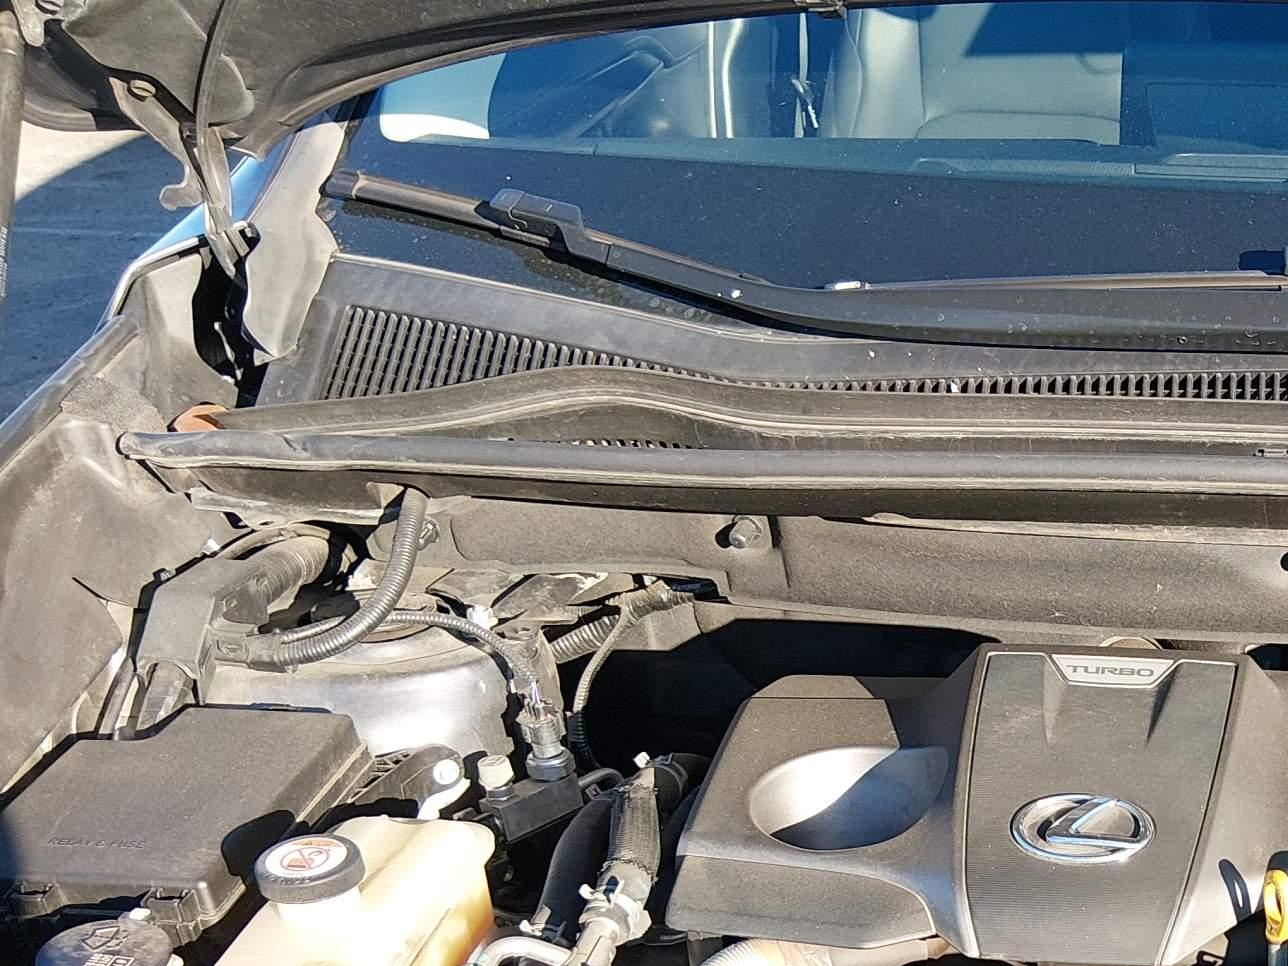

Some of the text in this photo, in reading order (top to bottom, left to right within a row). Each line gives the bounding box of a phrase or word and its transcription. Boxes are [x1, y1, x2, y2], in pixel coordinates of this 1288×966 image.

[1066, 665, 1155, 677] TURBO
[48, 837, 147, 849] RELAY & FUSE
